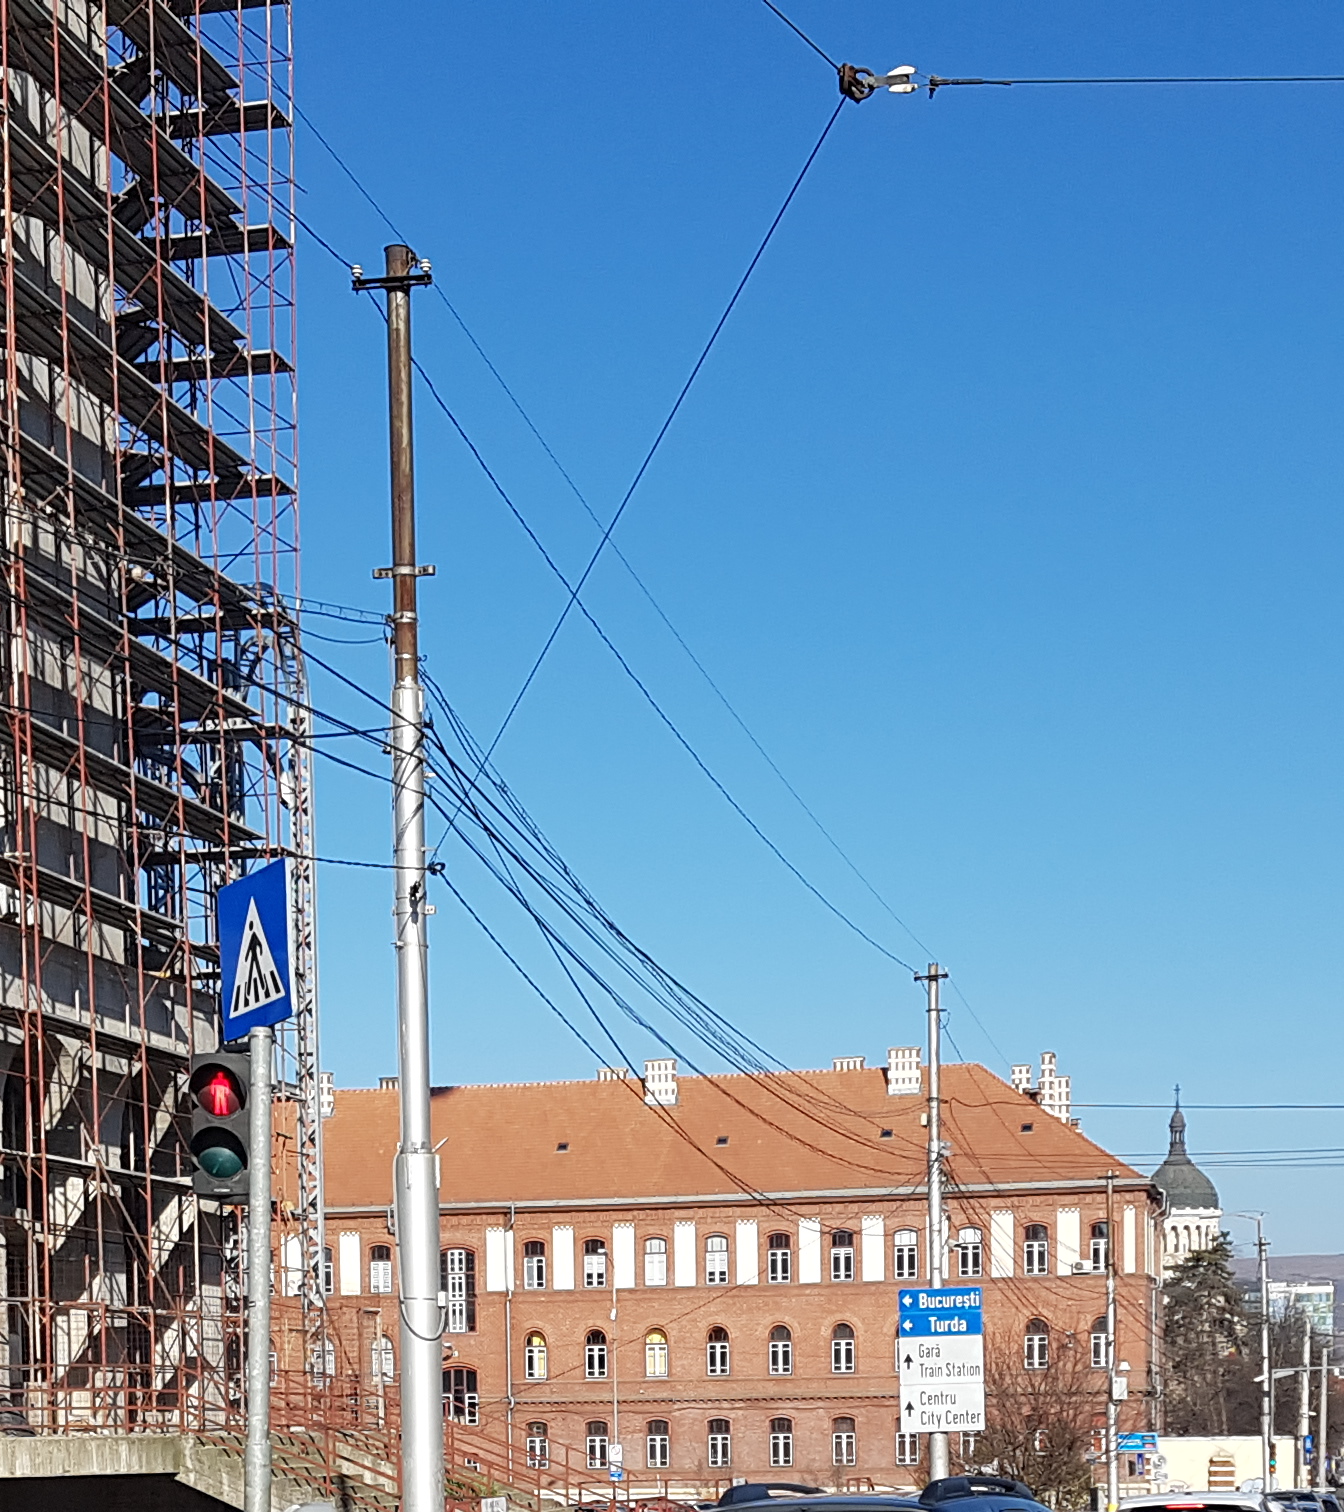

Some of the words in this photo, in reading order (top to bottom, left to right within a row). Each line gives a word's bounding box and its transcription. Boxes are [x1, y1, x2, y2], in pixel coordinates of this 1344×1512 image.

[918, 1291, 980, 1309] București
[928, 1316, 967, 1333] Turda
[918, 1344, 941, 1358] Gară
[919, 1363, 943, 1378] Train
[945, 1362, 981, 1377] Station
[920, 1390, 957, 1406] Centru
[920, 1411, 942, 1429] City
[945, 1410, 981, 1425] Center
